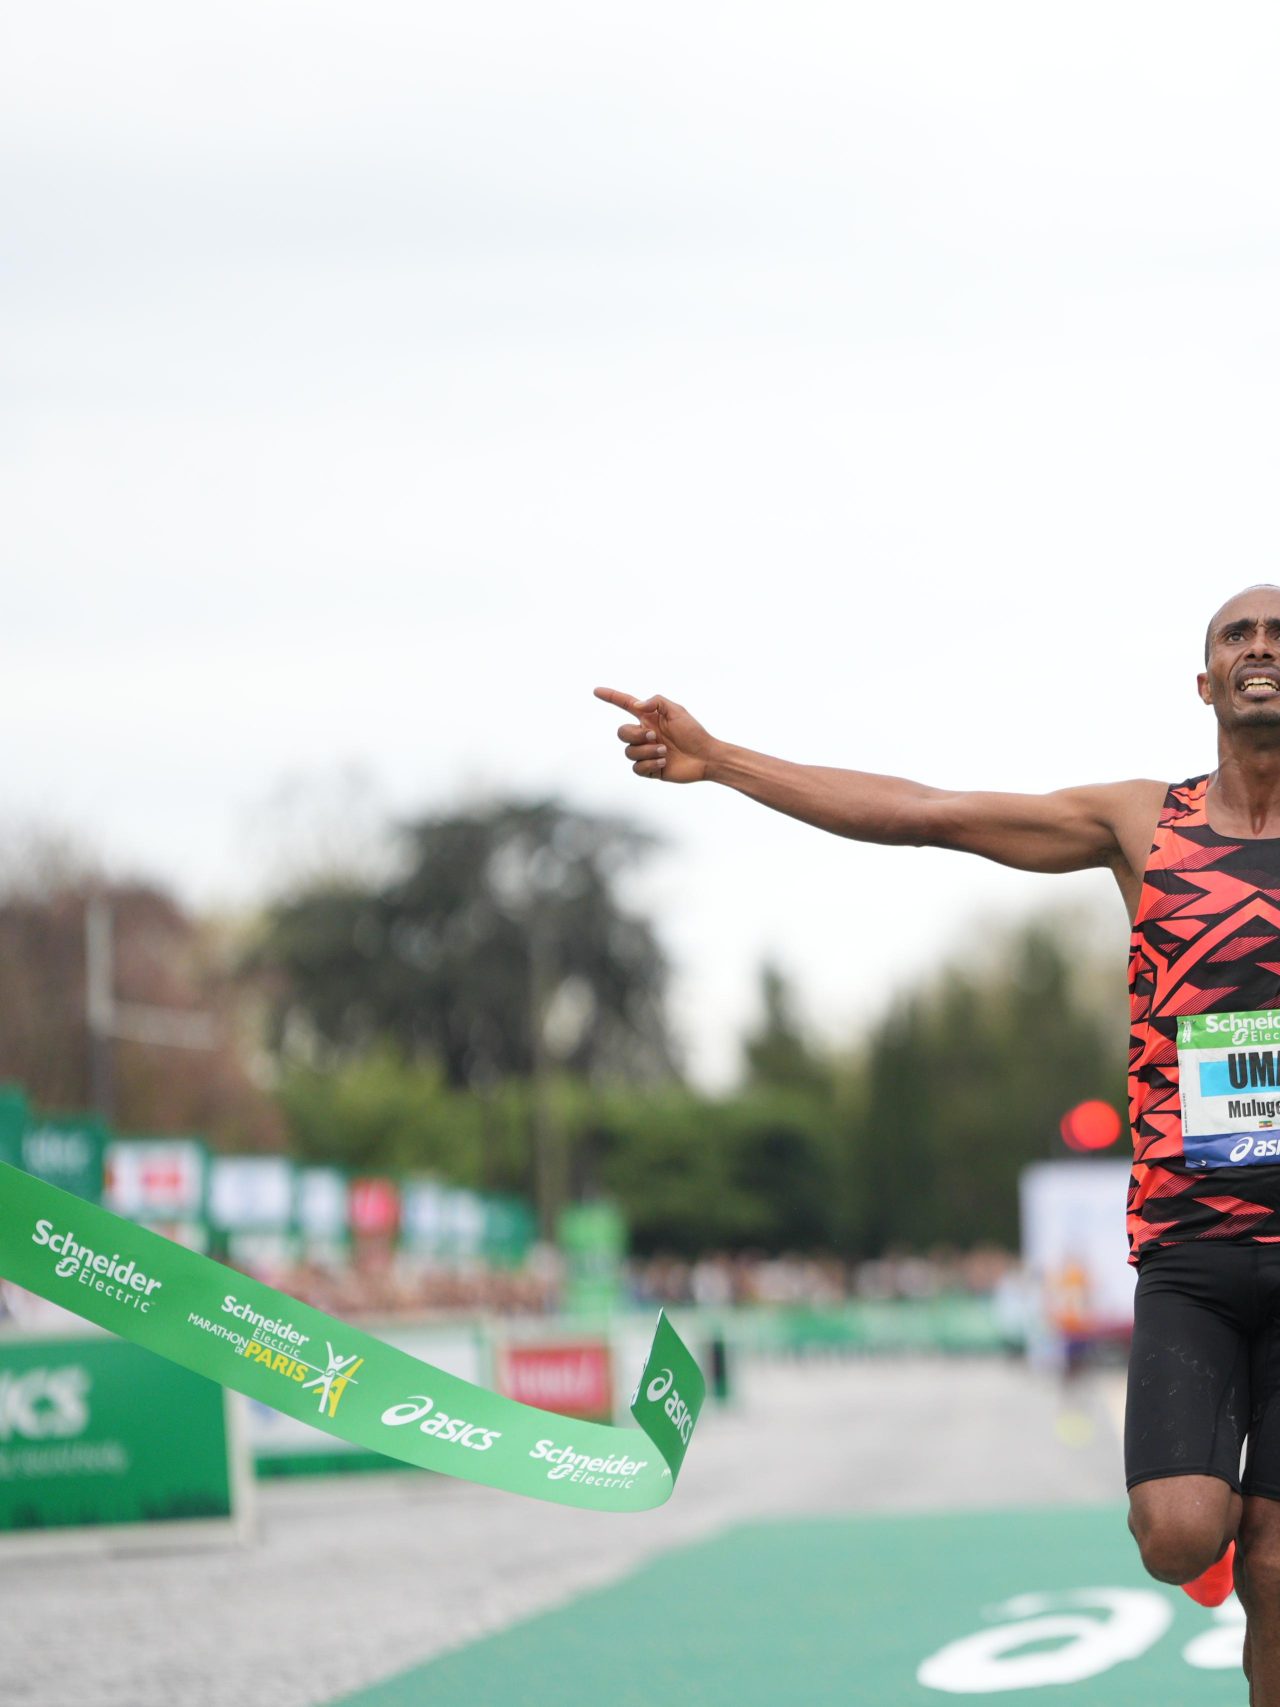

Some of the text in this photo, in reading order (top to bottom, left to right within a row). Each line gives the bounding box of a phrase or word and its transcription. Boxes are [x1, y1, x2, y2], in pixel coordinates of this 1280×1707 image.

[31, 1219, 162, 1296] Schneider
[78, 1268, 150, 1313] Electric
[187, 1312, 250, 1348] MARATHON
[221, 1295, 310, 1346] Schneider
[243, 1339, 309, 1382] PARIS
[252, 1327, 302, 1358] Electric
[529, 1439, 648, 1476] Schneider
[570, 1469, 635, 1489] Electric
